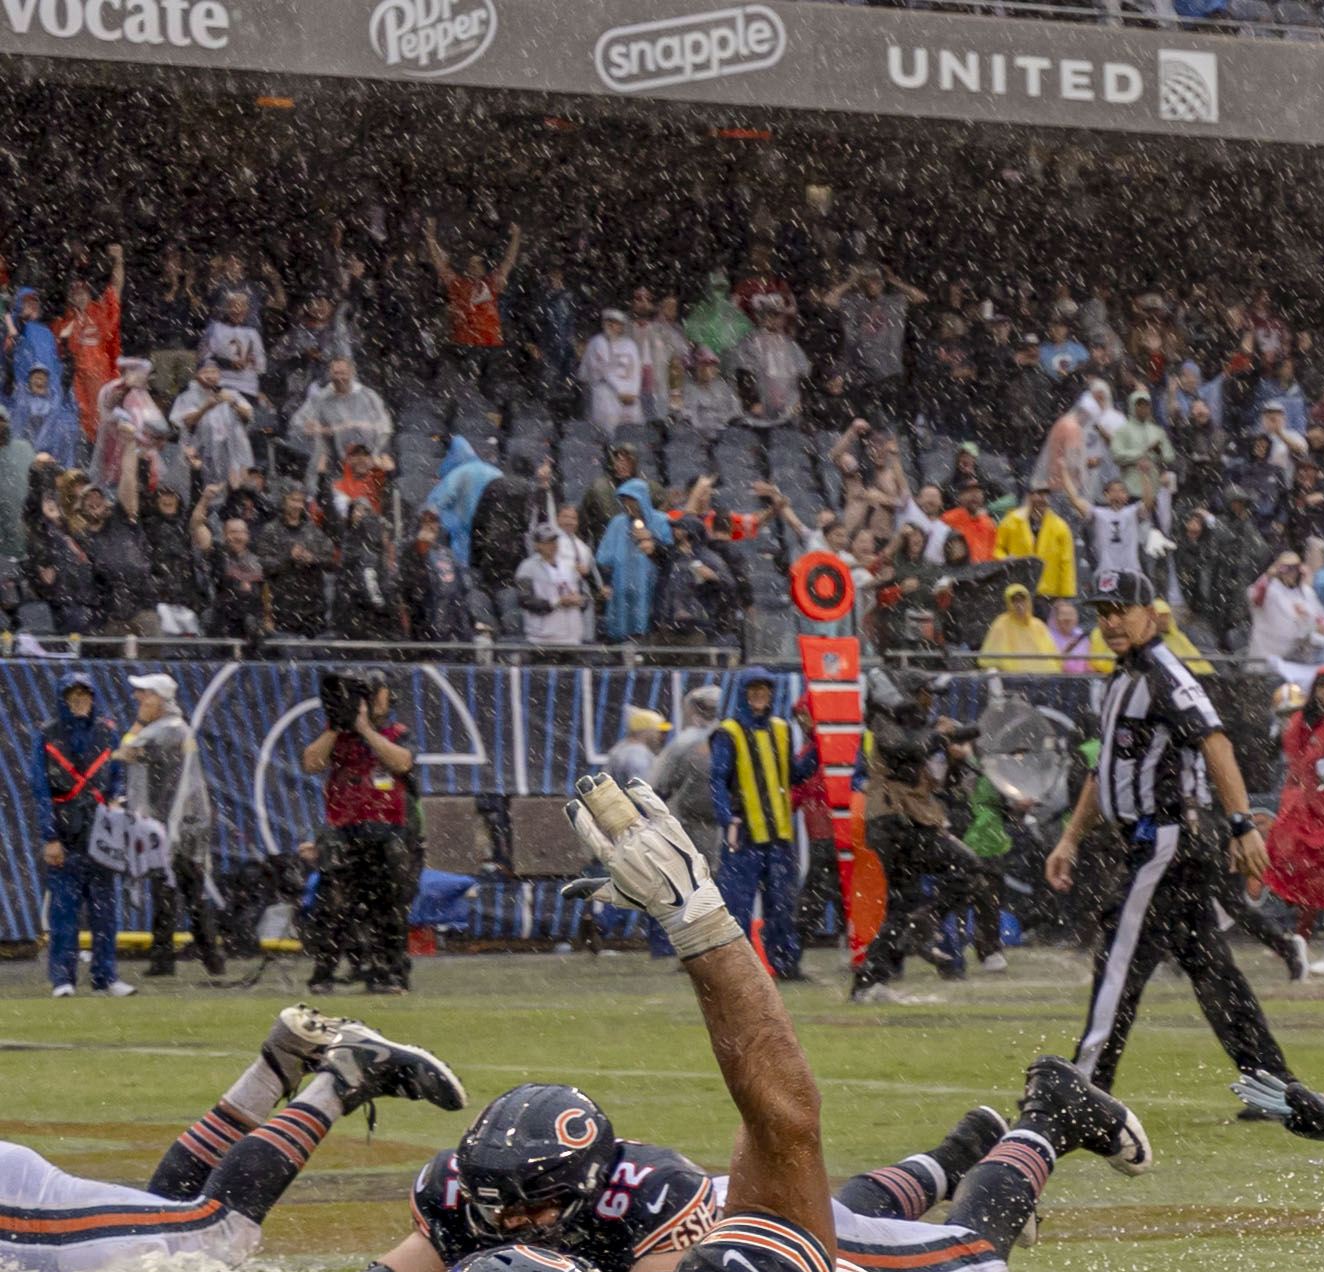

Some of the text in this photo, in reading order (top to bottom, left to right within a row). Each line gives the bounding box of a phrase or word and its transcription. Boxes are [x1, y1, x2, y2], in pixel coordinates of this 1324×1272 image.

[370, 0, 488, 65] Pepper
[608, 8, 774, 78] snapple
[887, 46, 1144, 103] UNITED
[596, 1160, 656, 1221] 62
[671, 1197, 722, 1252] GSH
